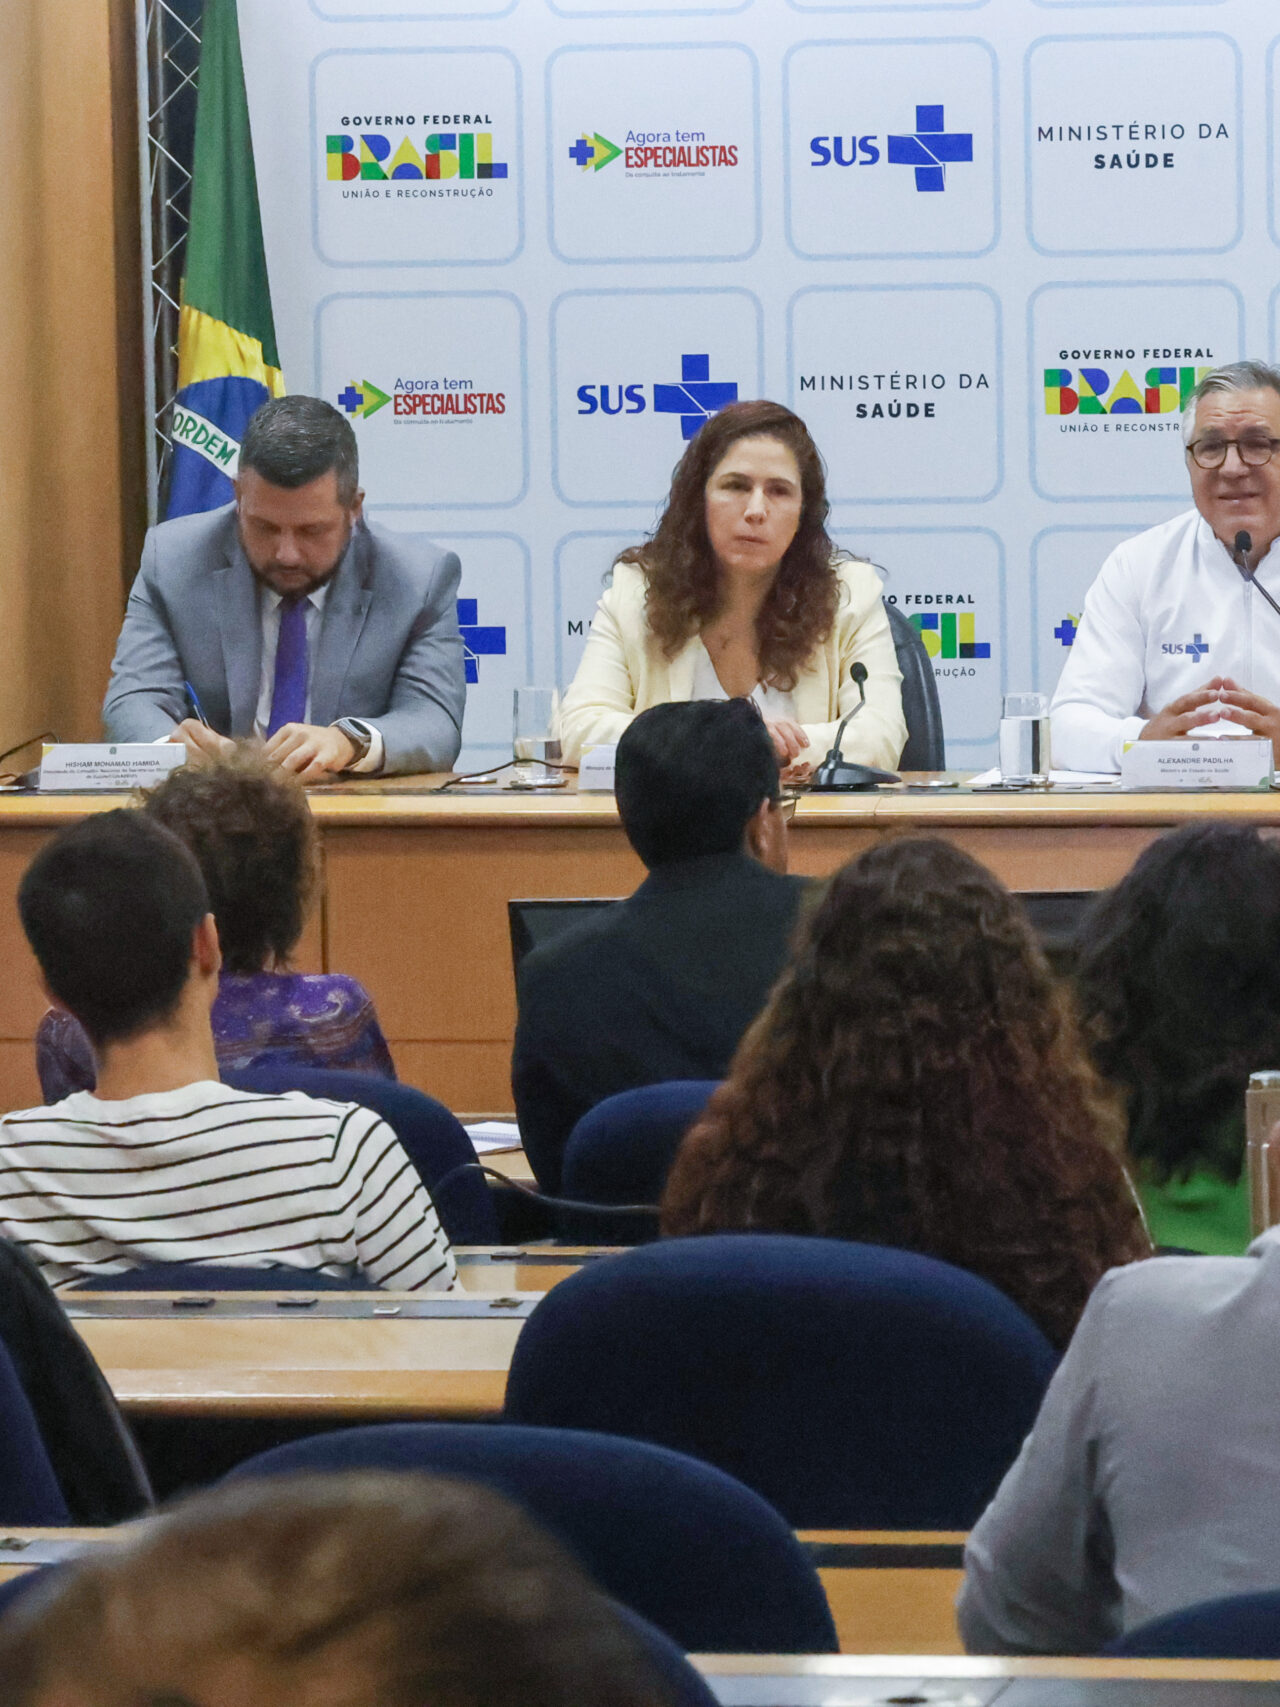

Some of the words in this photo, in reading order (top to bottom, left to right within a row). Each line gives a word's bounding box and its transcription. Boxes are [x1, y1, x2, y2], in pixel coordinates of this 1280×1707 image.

[341, 116, 416, 127] GOVERNO
[424, 115, 493, 125] FEDERAL
[626, 131, 671, 147] Agora
[676, 130, 706, 143] tem
[1038, 121, 1185, 142] MINISTÉRIO
[1199, 124, 1229, 139] DA
[326, 133, 508, 181] BRASIL
[626, 145, 738, 168] ESPECIALISTAS
[810, 136, 880, 166] SUS
[1094, 150, 1175, 170] SAÚDE
[343, 189, 380, 199] UNIÃO
[385, 190, 392, 199] E
[397, 187, 494, 199] RECONSTRUÇÃO
[1060, 349, 1136, 361] GOVERNO
[1144, 349, 1214, 359] FEDERAL
[394, 377, 439, 394] Agora
[443, 378, 473, 391] tem
[801, 371, 946, 391] MINISTÉRIO
[960, 374, 990, 390] DA
[395, 393, 505, 415] ESPECIALISTAS
[577, 385, 646, 415] SUS
[856, 399, 935, 419] SAÚDE
[1061, 423, 1099, 433] UNIÃO
[1104, 424, 1110, 433] E
[1115, 422, 1180, 432] RECONSTR
[172, 412, 237, 466] ORDEM
[906, 595, 975, 605] FEDERAL
[908, 612, 991, 659] SIL
[1162, 644, 1183, 654] SUS
